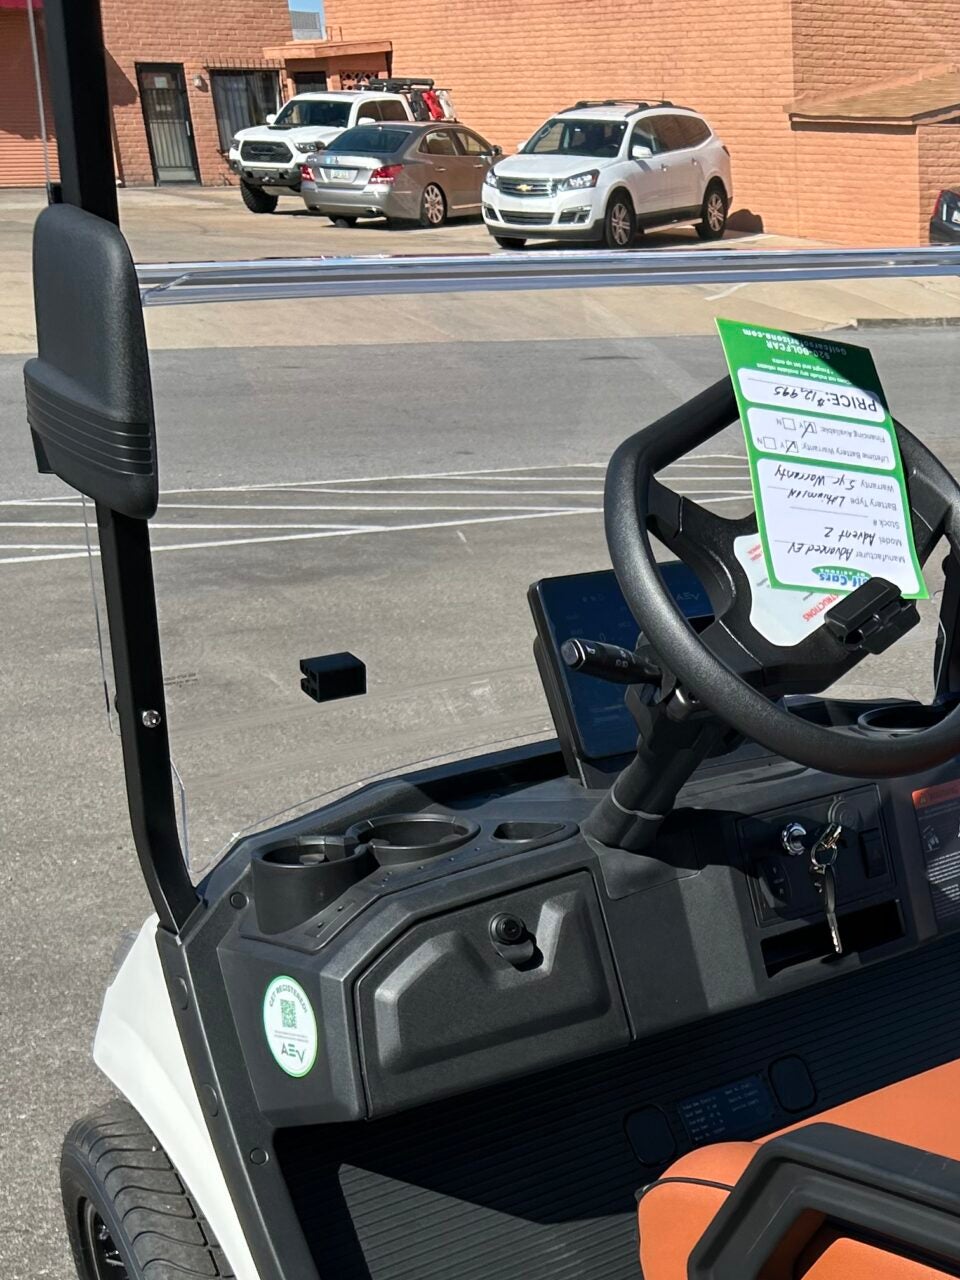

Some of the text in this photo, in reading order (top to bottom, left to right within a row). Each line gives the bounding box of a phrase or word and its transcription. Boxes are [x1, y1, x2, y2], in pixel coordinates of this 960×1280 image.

[826, 391, 878, 412] PRICE:
[852, 431, 886, 443] Financing
[836, 448, 862, 460] Battery
[862, 452, 890, 463] Lifetime
[775, 464, 825, 487] Warranty
[832, 475, 846, 488] yr
[845, 480, 856, 491] 5
[869, 500, 898, 511] Battery
[878, 519, 900, 530] Stock
[838, 530, 876, 546] Advent
[788, 542, 804, 554] EV
[806, 544, 854, 562] Advanced
[819, 574, 848, 586] Cars
